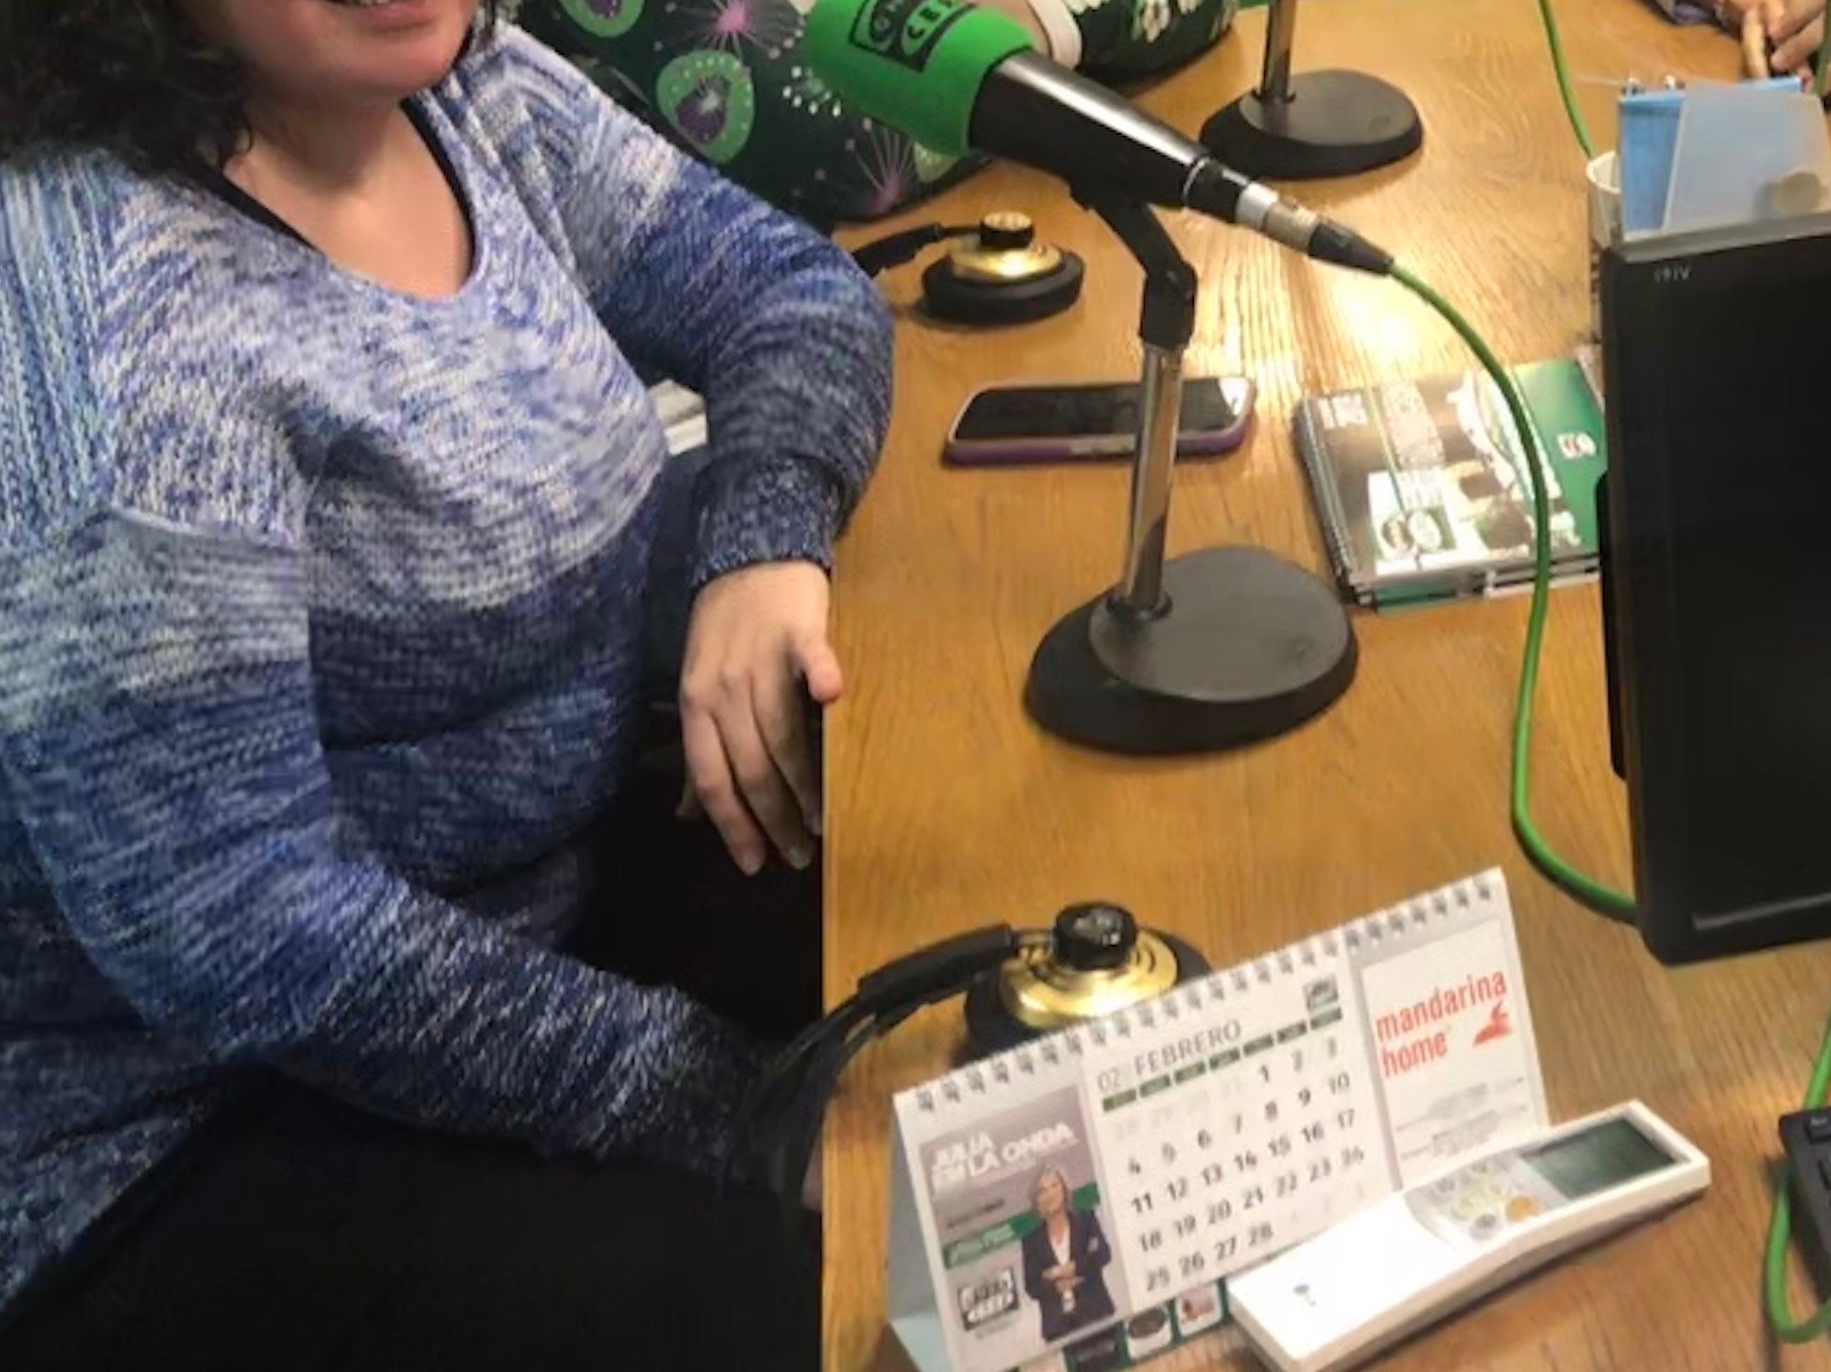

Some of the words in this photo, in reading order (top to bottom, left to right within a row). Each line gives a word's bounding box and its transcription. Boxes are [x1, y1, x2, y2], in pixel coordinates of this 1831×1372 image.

[1376, 970, 1507, 1042] mandarina
[1134, 1019, 1241, 1075] FEBRERO
[1382, 1031, 1447, 1078] home
[968, 1150, 1001, 1178] LA
[1001, 1122, 1080, 1164] ONDA
[1131, 1192, 1153, 1213] 11
[1167, 1178, 1188, 1201] 12
[1201, 1163, 1223, 1185] 13
[1233, 1150, 1258, 1171] 14
[1300, 1121, 1325, 1143] 16
[1338, 1108, 1355, 1130] 17
[1174, 1215, 1197, 1237] 19
[1207, 1199, 1232, 1225] 20
[1178, 1251, 1205, 1276] 26
[1214, 1236, 1238, 1261] 27
